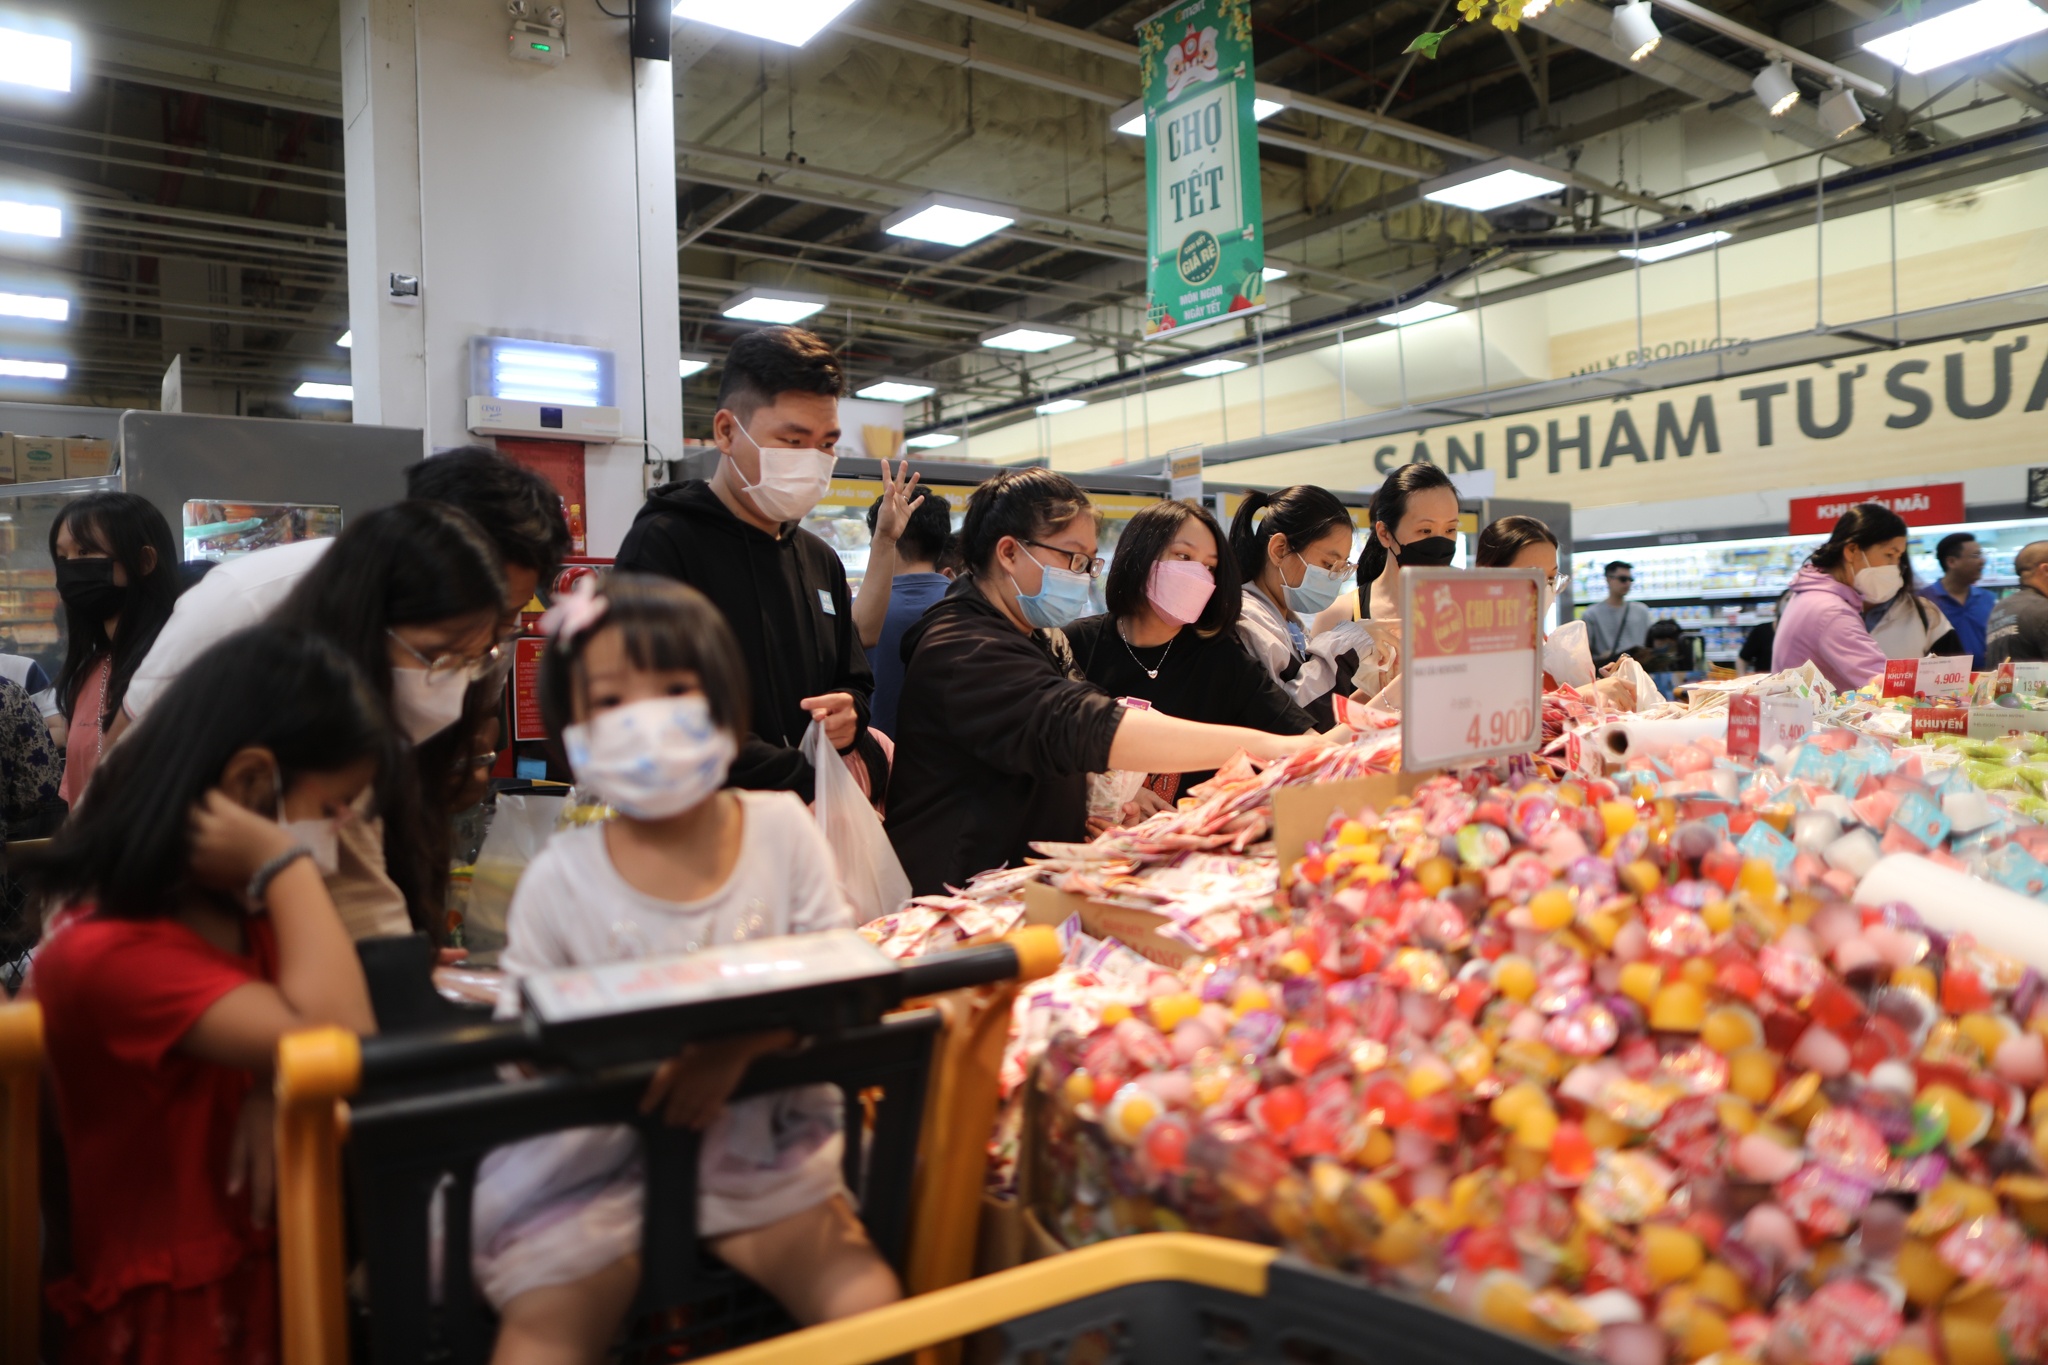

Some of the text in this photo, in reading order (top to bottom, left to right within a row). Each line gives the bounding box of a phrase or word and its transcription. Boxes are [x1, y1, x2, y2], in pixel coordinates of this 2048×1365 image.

[1168, 97, 1222, 162] CHỢ
[1170, 161, 1224, 223] TẾT
[1180, 285, 1223, 306] MÓN NGON
[1184, 299, 1221, 320] NGÀY TẾT
[1626, 338, 1751, 366] PRODUCTS
[1740, 359, 1868, 448] TỪ
[1894, 493, 1930, 513] MÃI
[1934, 672, 1961, 685] 4.900
[1465, 707, 1531, 749] 4.900
[1779, 723, 1805, 741] 5.400
[1915, 717, 1964, 730] KHUYẾN
